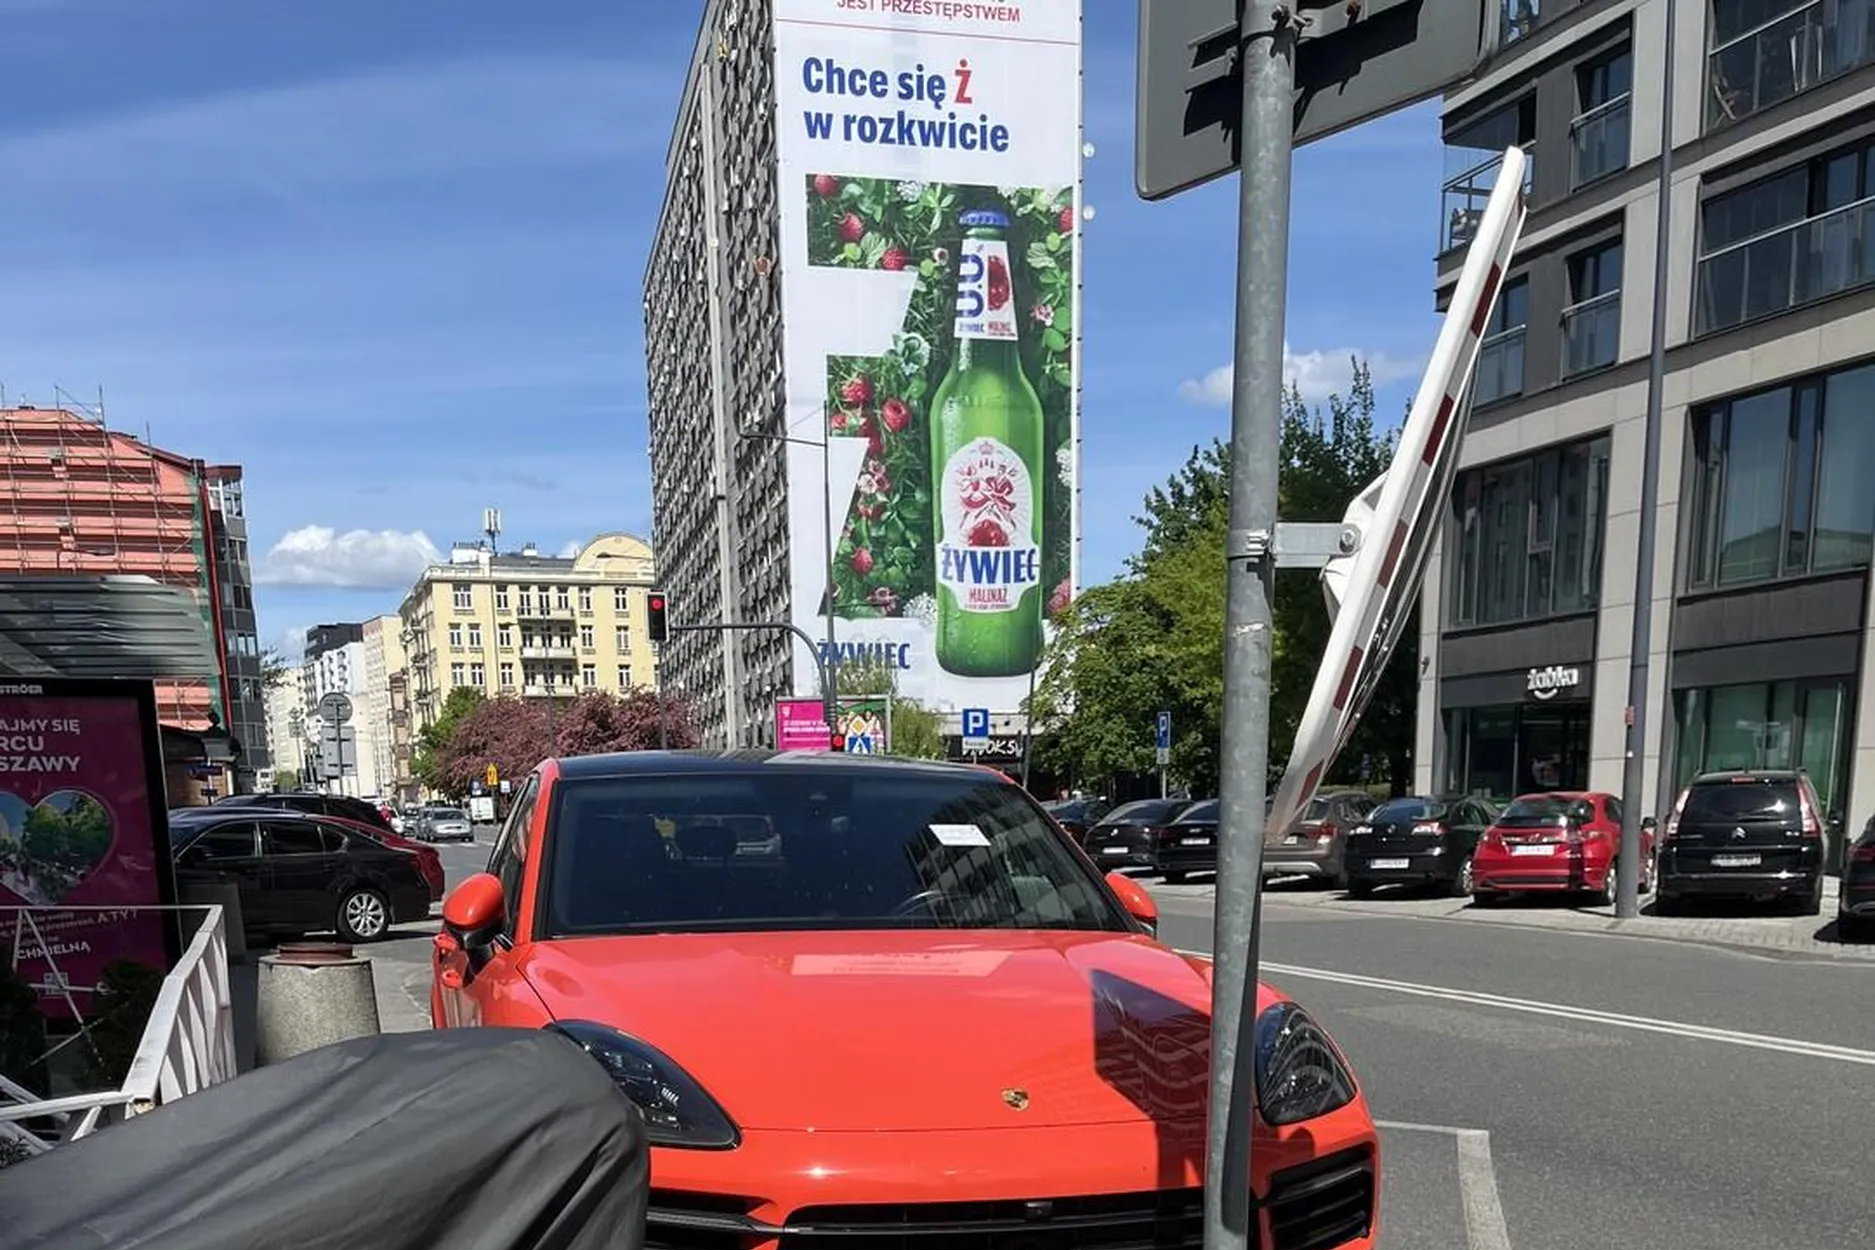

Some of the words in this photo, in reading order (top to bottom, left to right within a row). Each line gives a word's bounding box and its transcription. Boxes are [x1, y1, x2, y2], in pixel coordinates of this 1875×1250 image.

[881, 0, 1020, 22] PRZESTĘPSTWEM
[802, 56, 888, 97] Chce
[897, 64, 946, 110] się
[954, 59, 973, 104] Ż
[803, 111, 833, 139] w
[843, 110, 1009, 152] rozkwicie
[941, 544, 1037, 585] ŻYWIEC
[52, 719, 81, 735] SIĘ
[968, 711, 984, 735] P
